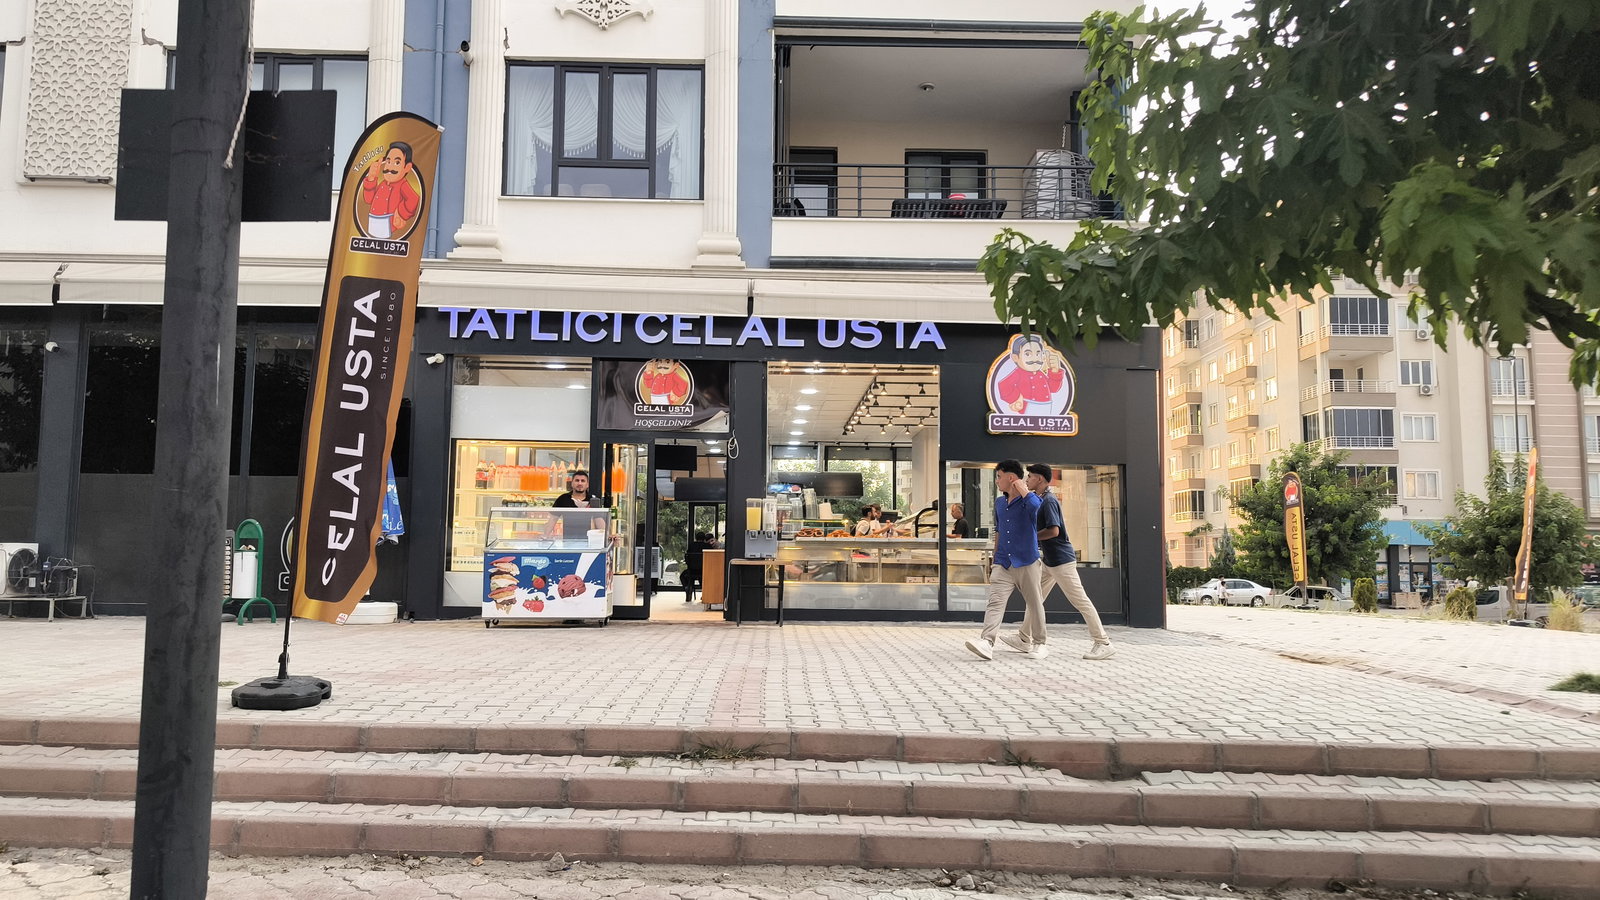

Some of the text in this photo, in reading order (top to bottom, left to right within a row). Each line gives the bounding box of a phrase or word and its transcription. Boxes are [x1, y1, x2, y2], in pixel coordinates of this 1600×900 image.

[352, 239, 407, 252] CELAL USTA
[438, 307, 947, 350] TATLICI CELAL USTA
[634, 419, 692, 428] HOŞGELDİNİZ
[993, 417, 1071, 427] CELAL USTA
[321, 289, 382, 587] CELAL USTA
